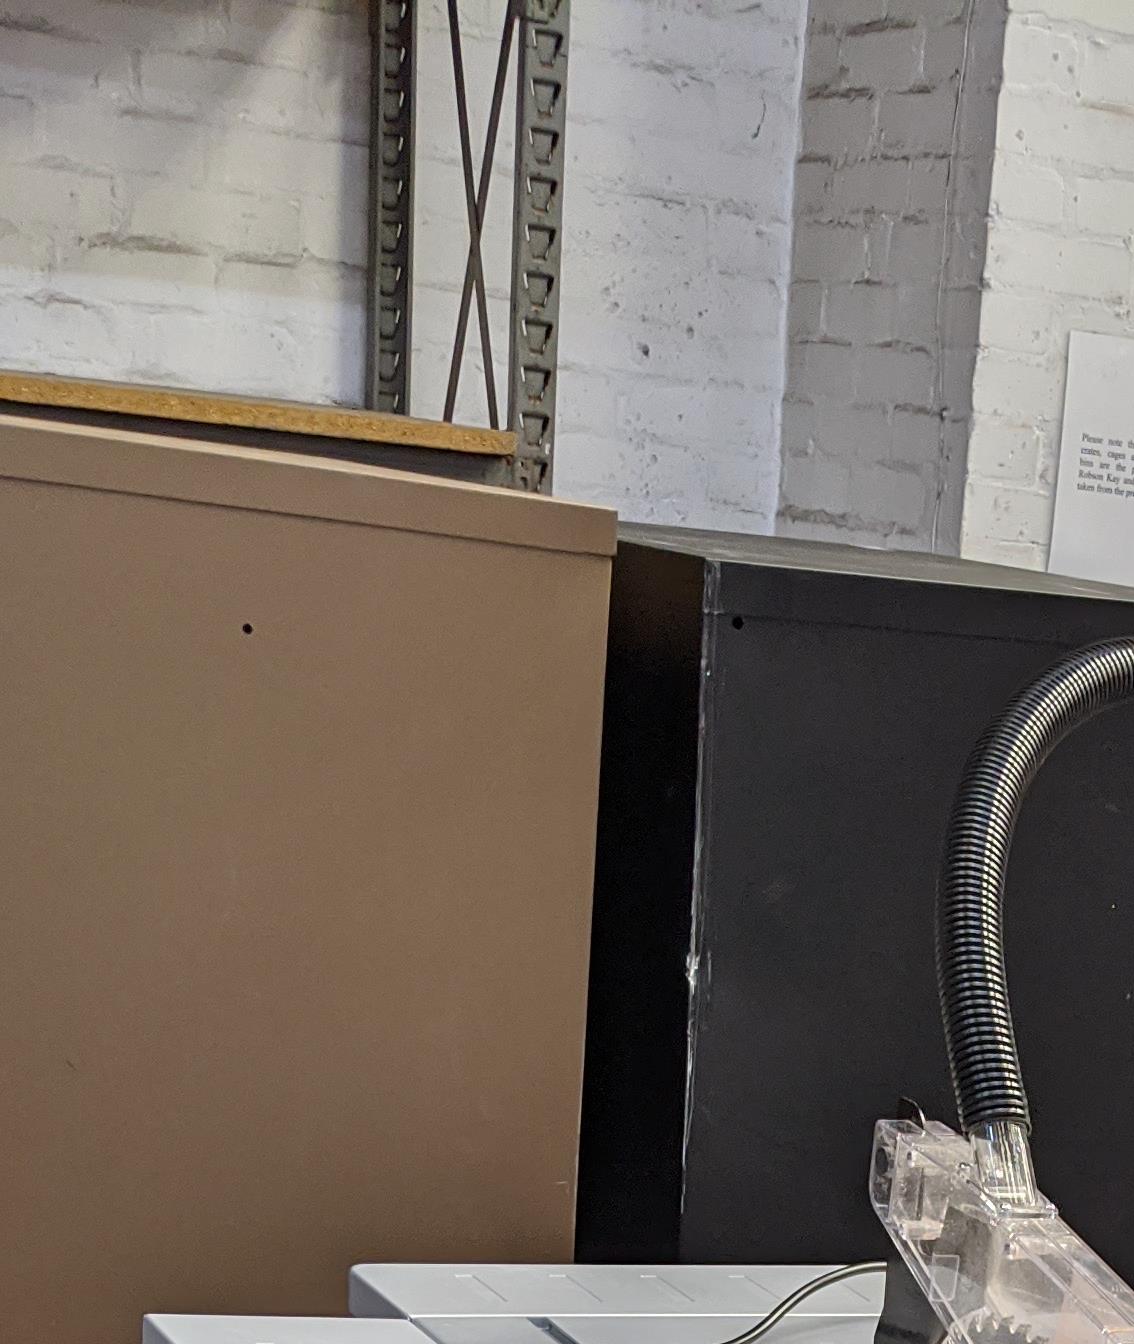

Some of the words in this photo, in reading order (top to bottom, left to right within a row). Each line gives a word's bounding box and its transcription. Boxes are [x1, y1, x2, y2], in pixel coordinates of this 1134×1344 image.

[1081, 433, 1103, 444] Please
[1108, 439, 1123, 447] note
[1107, 451, 1126, 460] cages
[1080, 457, 1094, 467] bins
[1100, 462, 1110, 470] are
[1115, 463, 1126, 472] the
[1106, 473, 1120, 484] Kay
[1077, 482, 1095, 492] taken
[1096, 484, 1113, 494] from
[1114, 487, 1125, 496] the
